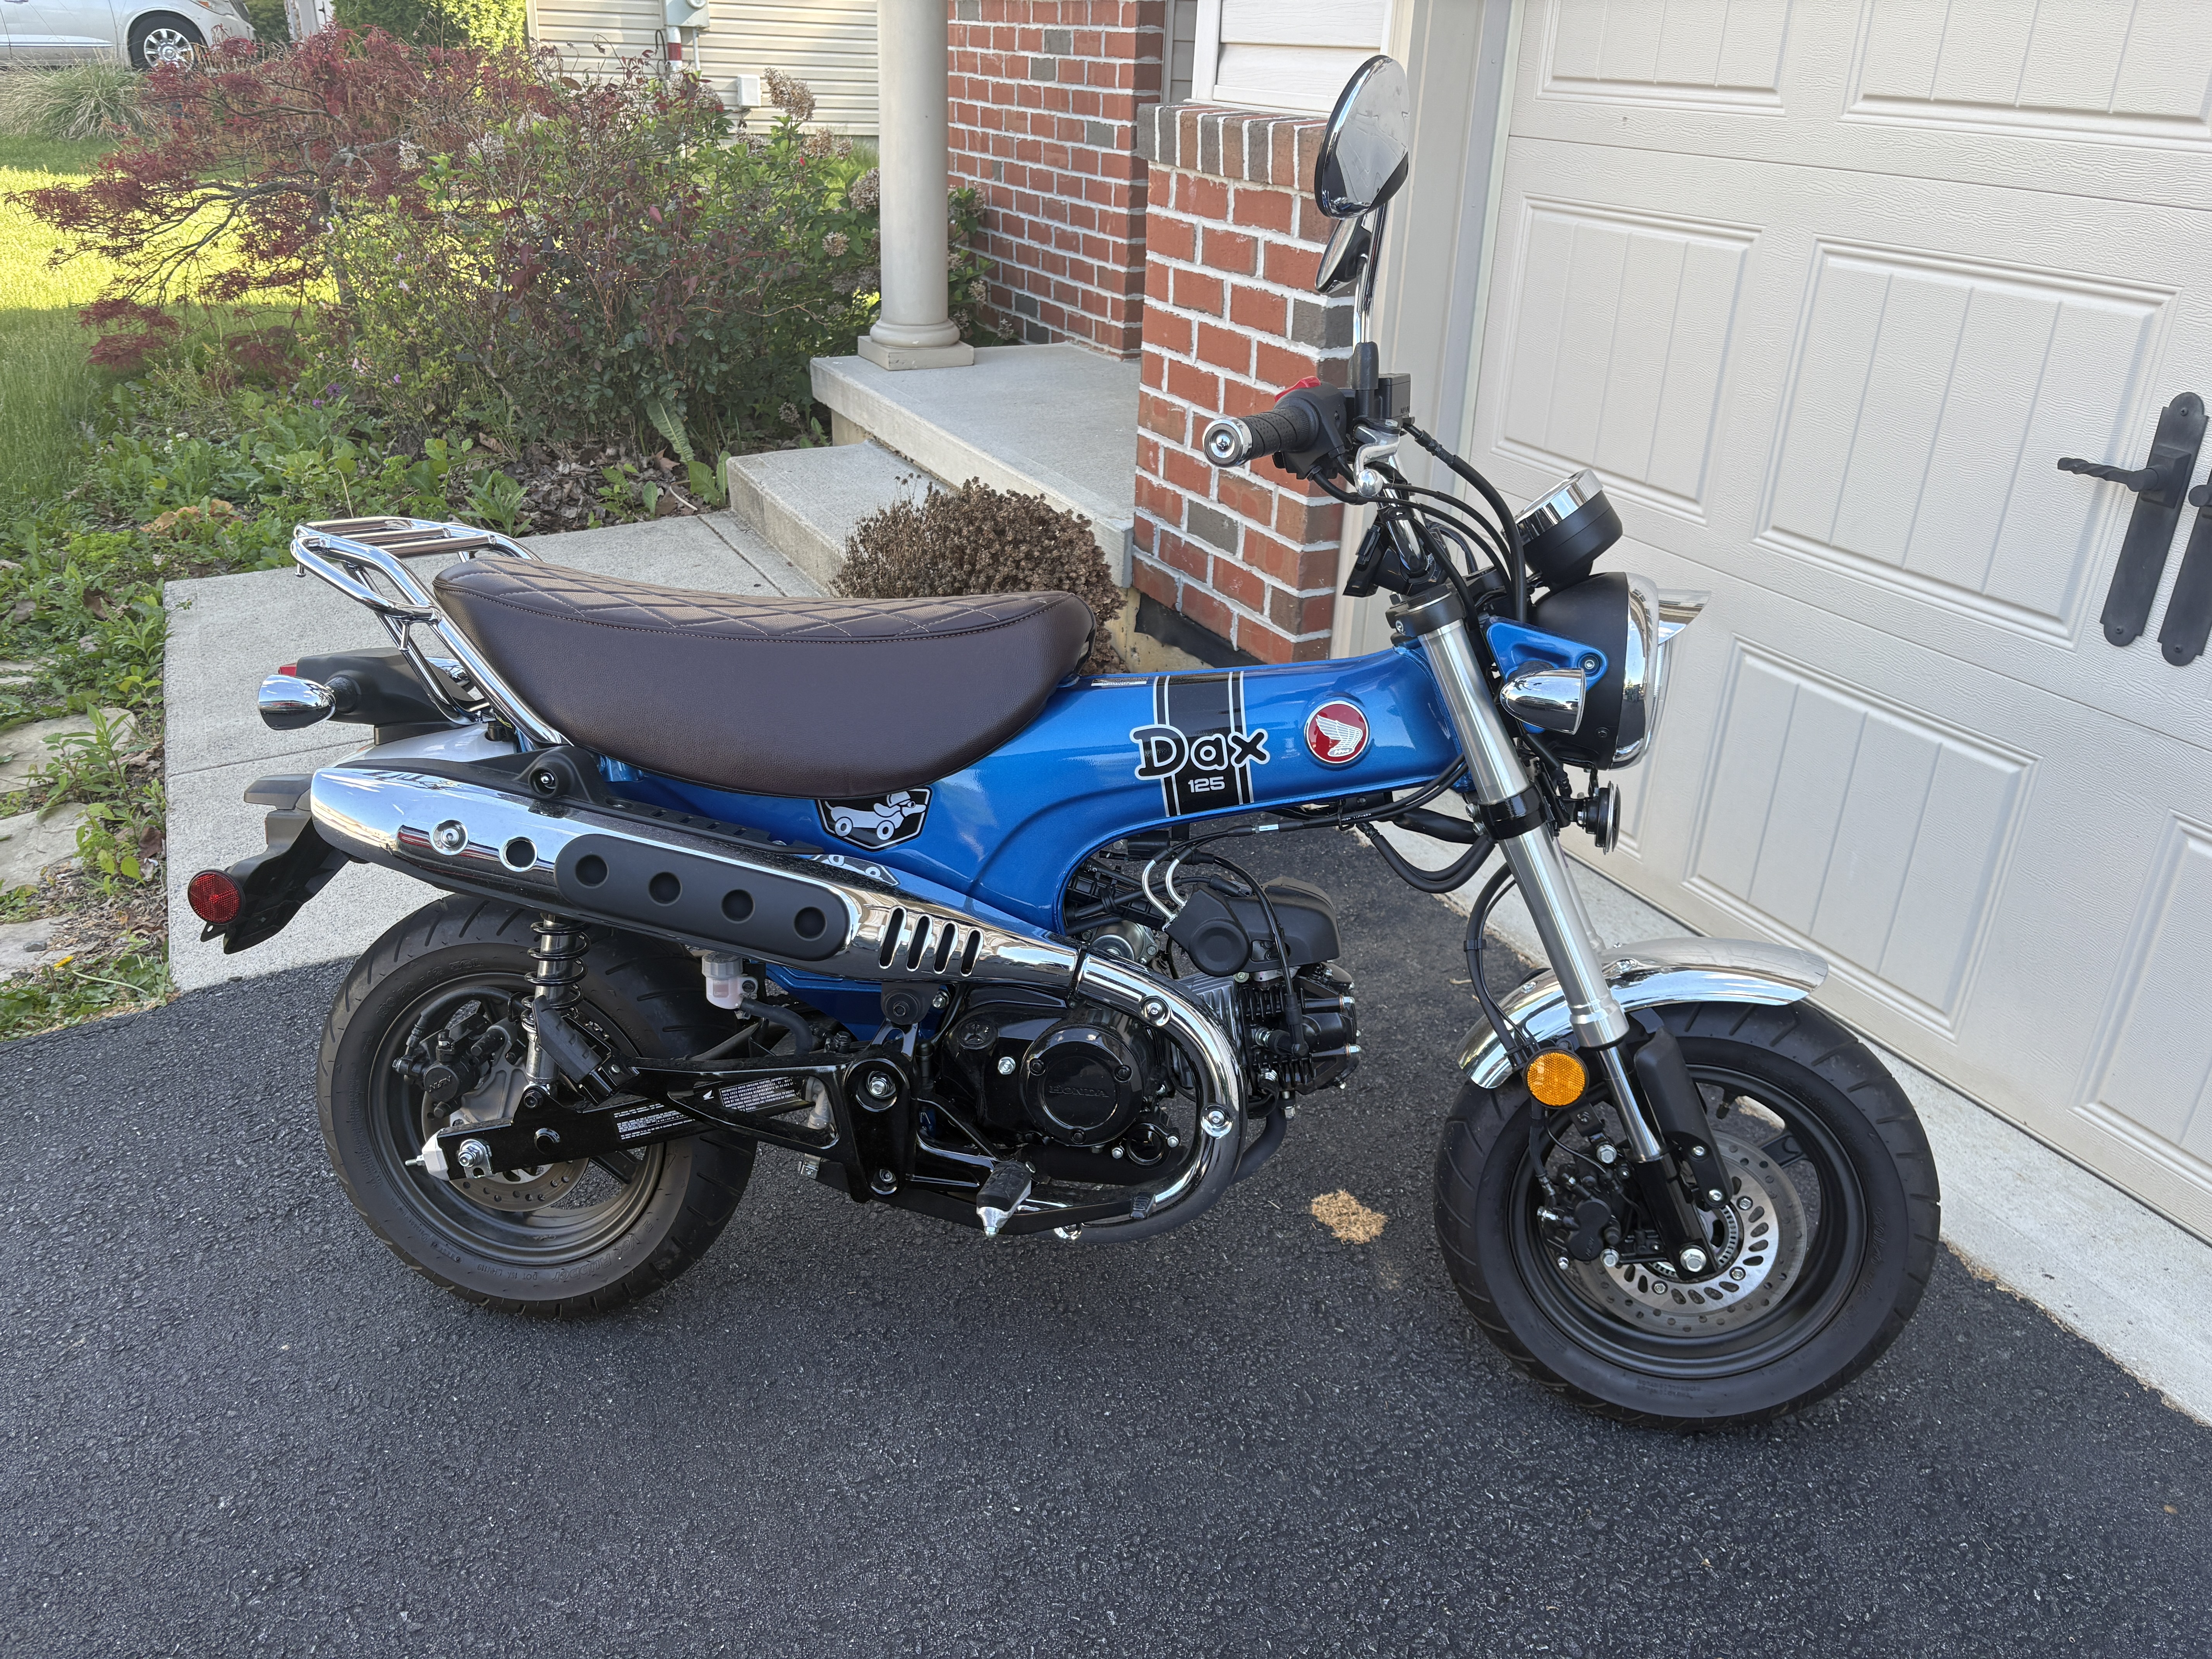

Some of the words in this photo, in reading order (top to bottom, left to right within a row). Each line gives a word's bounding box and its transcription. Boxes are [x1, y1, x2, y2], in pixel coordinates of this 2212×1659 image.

[1130, 724, 1271, 780] Dax
[1188, 776, 1225, 793] 125
[1048, 1085, 1109, 1097] HONDA
[552, 1254, 611, 1283] Rubber
